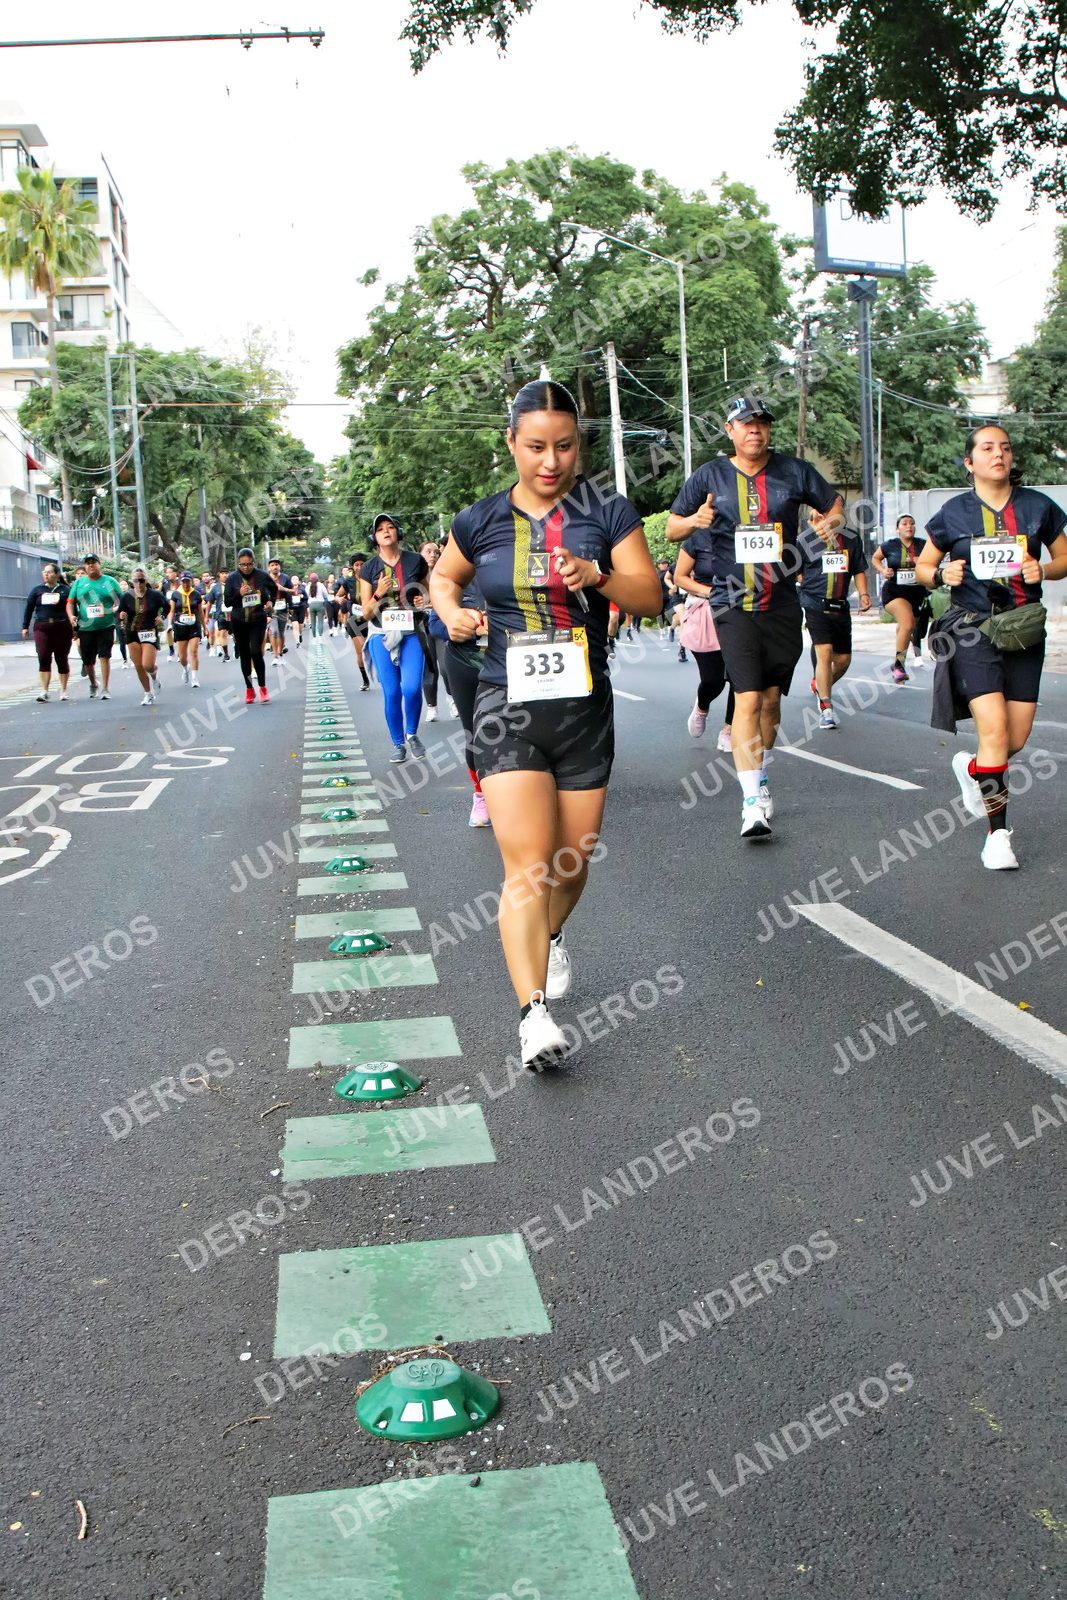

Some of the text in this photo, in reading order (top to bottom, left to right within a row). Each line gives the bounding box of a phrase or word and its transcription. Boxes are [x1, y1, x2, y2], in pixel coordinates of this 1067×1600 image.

[742, 536, 773, 549] 1634
[826, 556, 844, 565] 6675
[979, 549, 1014, 564] 1922
[390, 613, 406, 622] 942
[524, 652, 565, 677] 333
